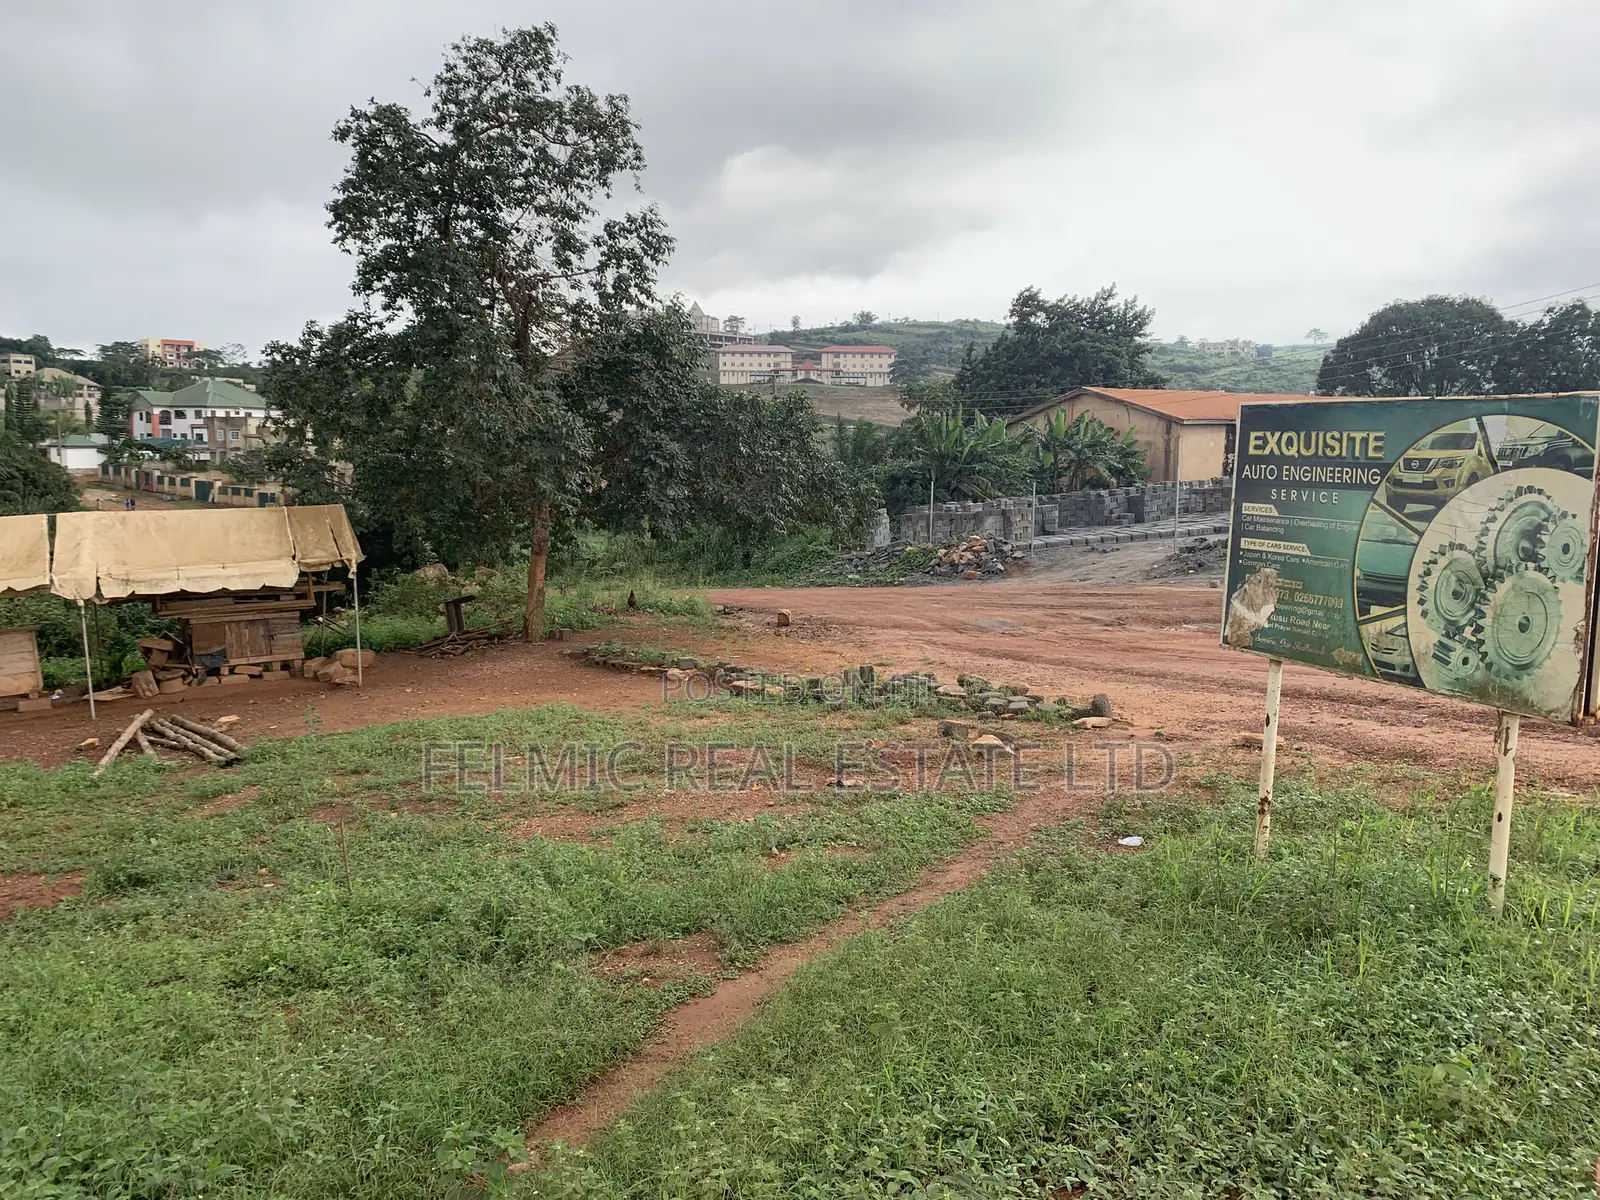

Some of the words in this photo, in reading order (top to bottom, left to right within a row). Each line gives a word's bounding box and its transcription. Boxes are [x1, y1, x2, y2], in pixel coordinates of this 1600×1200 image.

[1248, 431, 1385, 458] EXQUISITE
[1242, 464, 1278, 480] AUTO
[1282, 465, 1381, 485] ENGINEERING
[1270, 488, 1338, 504] SERVICE
[1242, 514, 1255, 522] Car
[1255, 515, 1290, 526] Maintenance
[1294, 518, 1328, 529] Overhauling
[1244, 523, 1256, 531] Car
[1257, 524, 1284, 535] Balancing
[1243, 539, 1256, 547] TYPE
[1266, 542, 1281, 550] CARS
[1243, 550, 1261, 560] Japan
[1267, 553, 1285, 562] Korea
[1285, 555, 1300, 563] Cars
[1305, 558, 1333, 568] American
[1290, 615, 1310, 627] Road
[1311, 619, 1332, 631] Near
